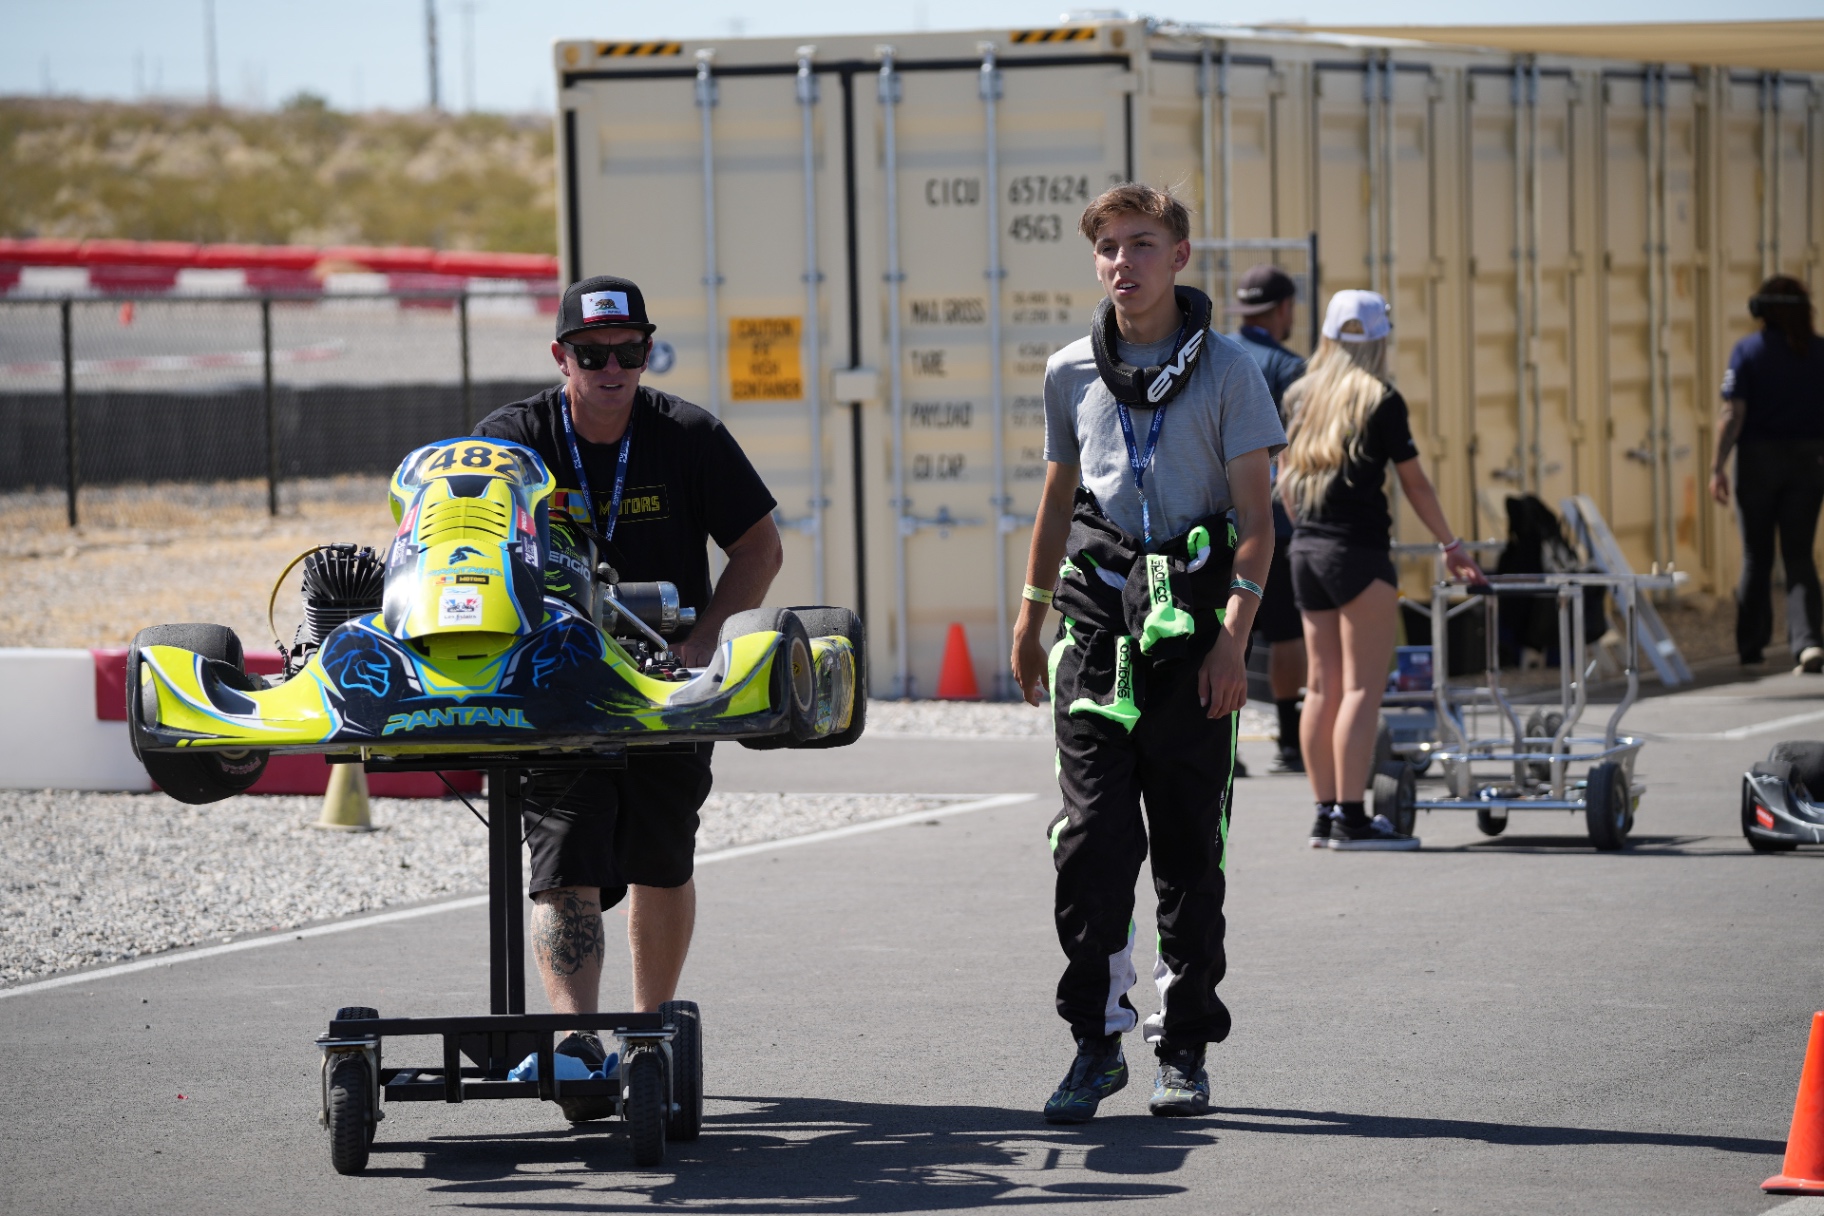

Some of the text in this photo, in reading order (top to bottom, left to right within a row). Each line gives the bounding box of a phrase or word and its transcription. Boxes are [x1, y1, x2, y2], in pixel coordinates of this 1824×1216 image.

[1007, 174, 1088, 204] 657624
[1147, 329, 1204, 402] EVS
[428, 446, 521, 476] 482
[598, 496, 661, 516] MTORS
[549, 550, 591, 582] ENGIO
[1117, 644, 1130, 699] sparco
